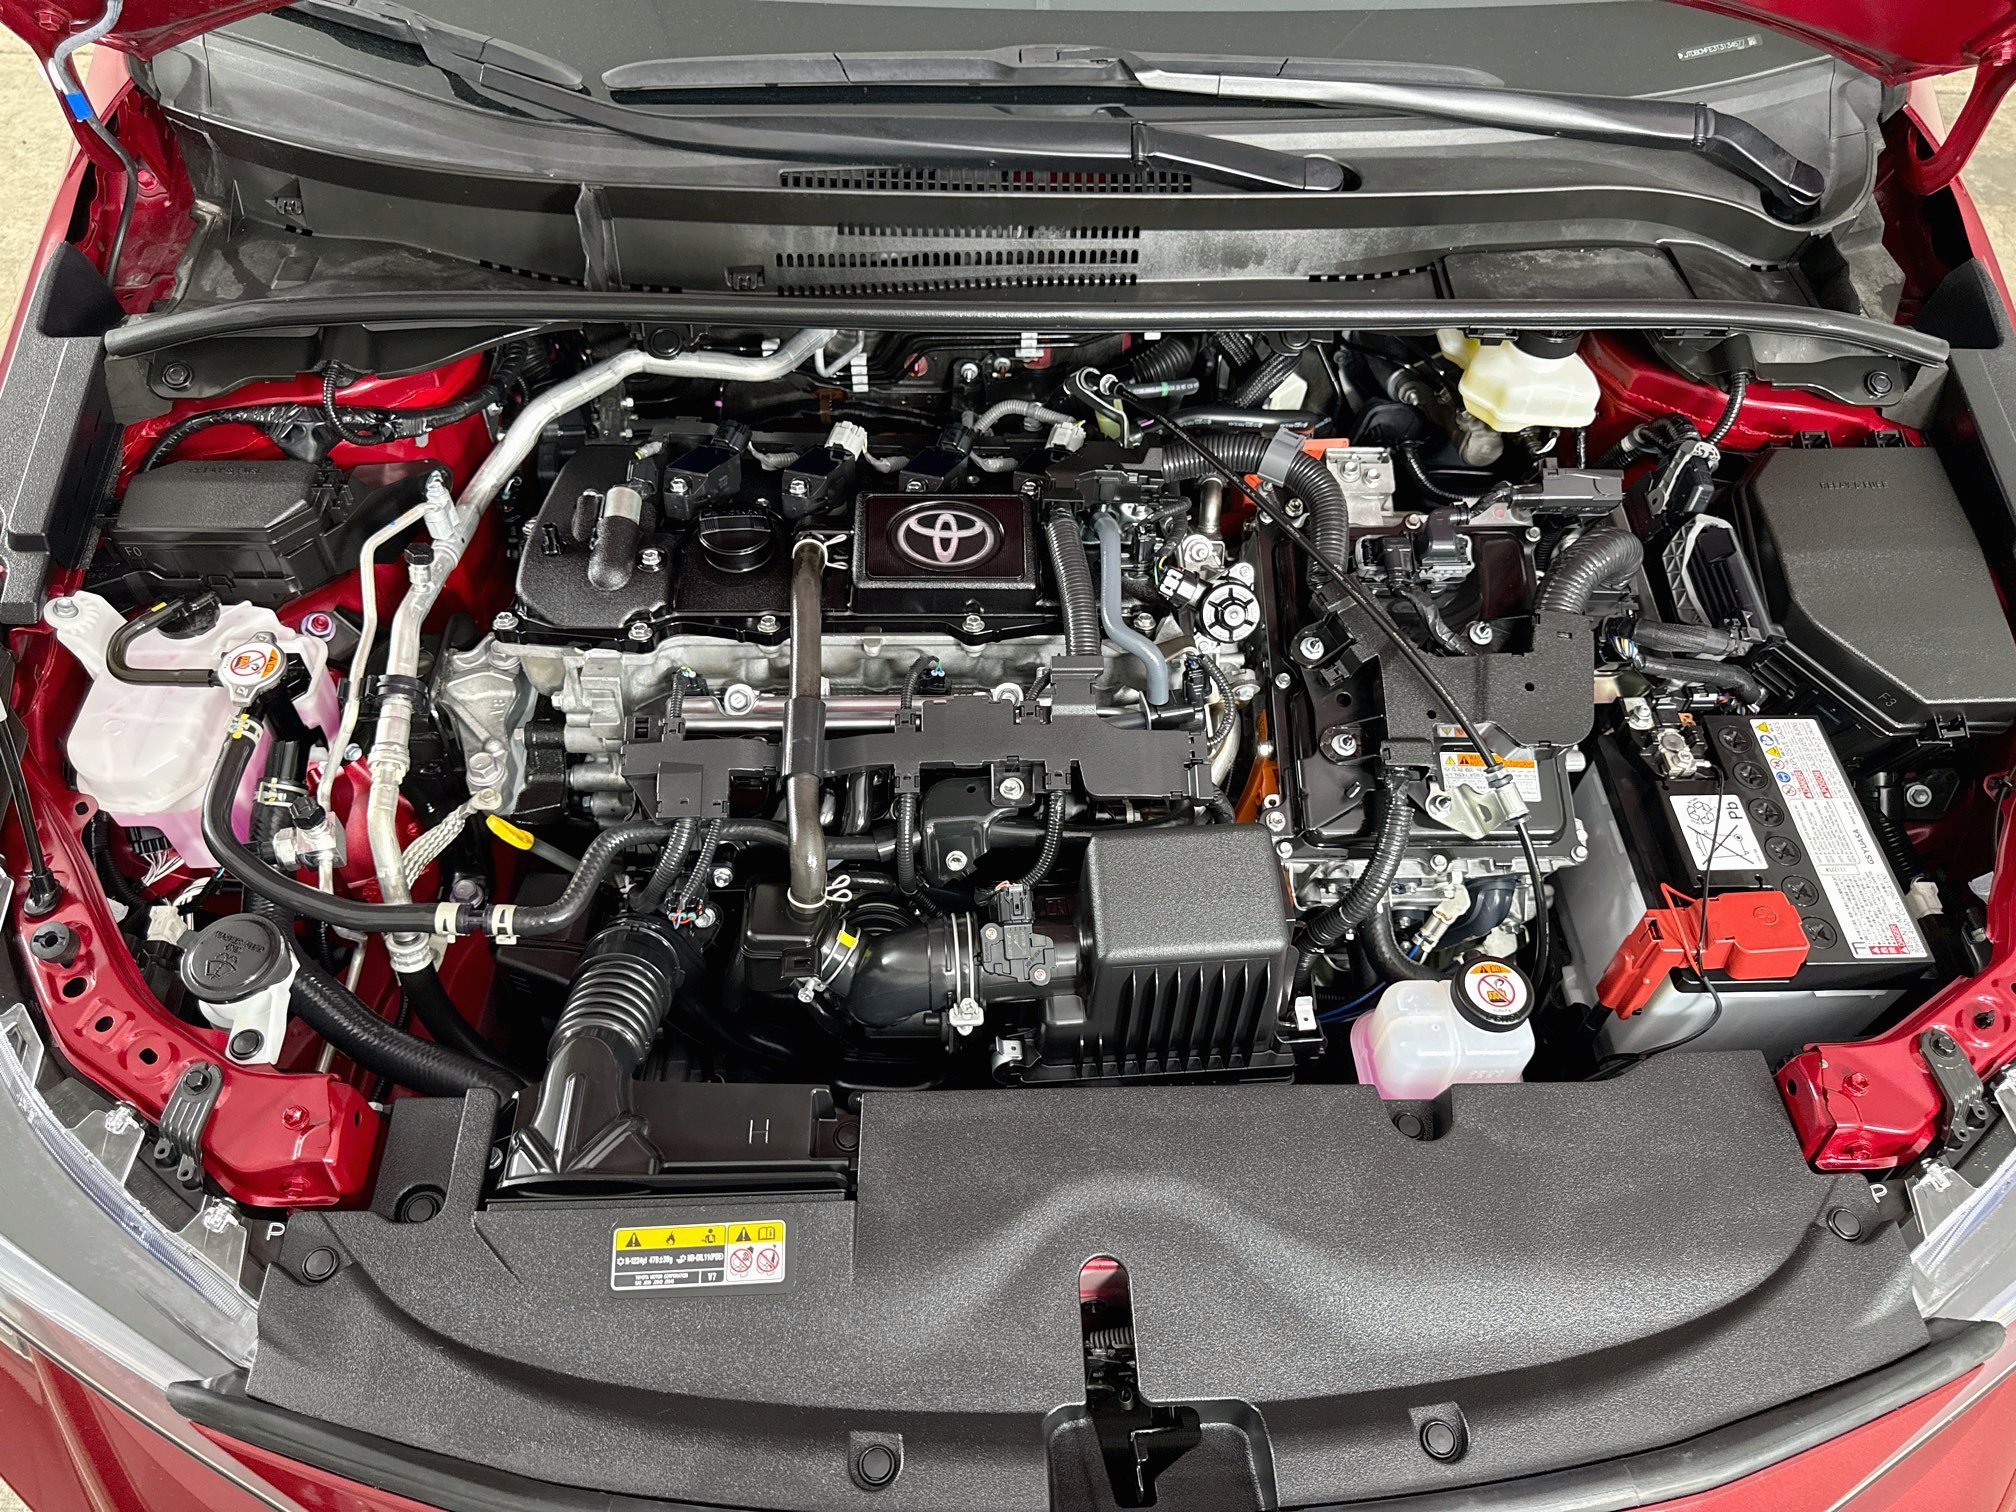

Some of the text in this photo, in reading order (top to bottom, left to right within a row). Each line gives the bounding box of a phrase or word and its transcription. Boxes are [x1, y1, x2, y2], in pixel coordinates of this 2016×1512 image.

[1726, 801, 1743, 819] Pb
[1869, 1183, 1888, 1203] P
[266, 1222, 286, 1241] P
